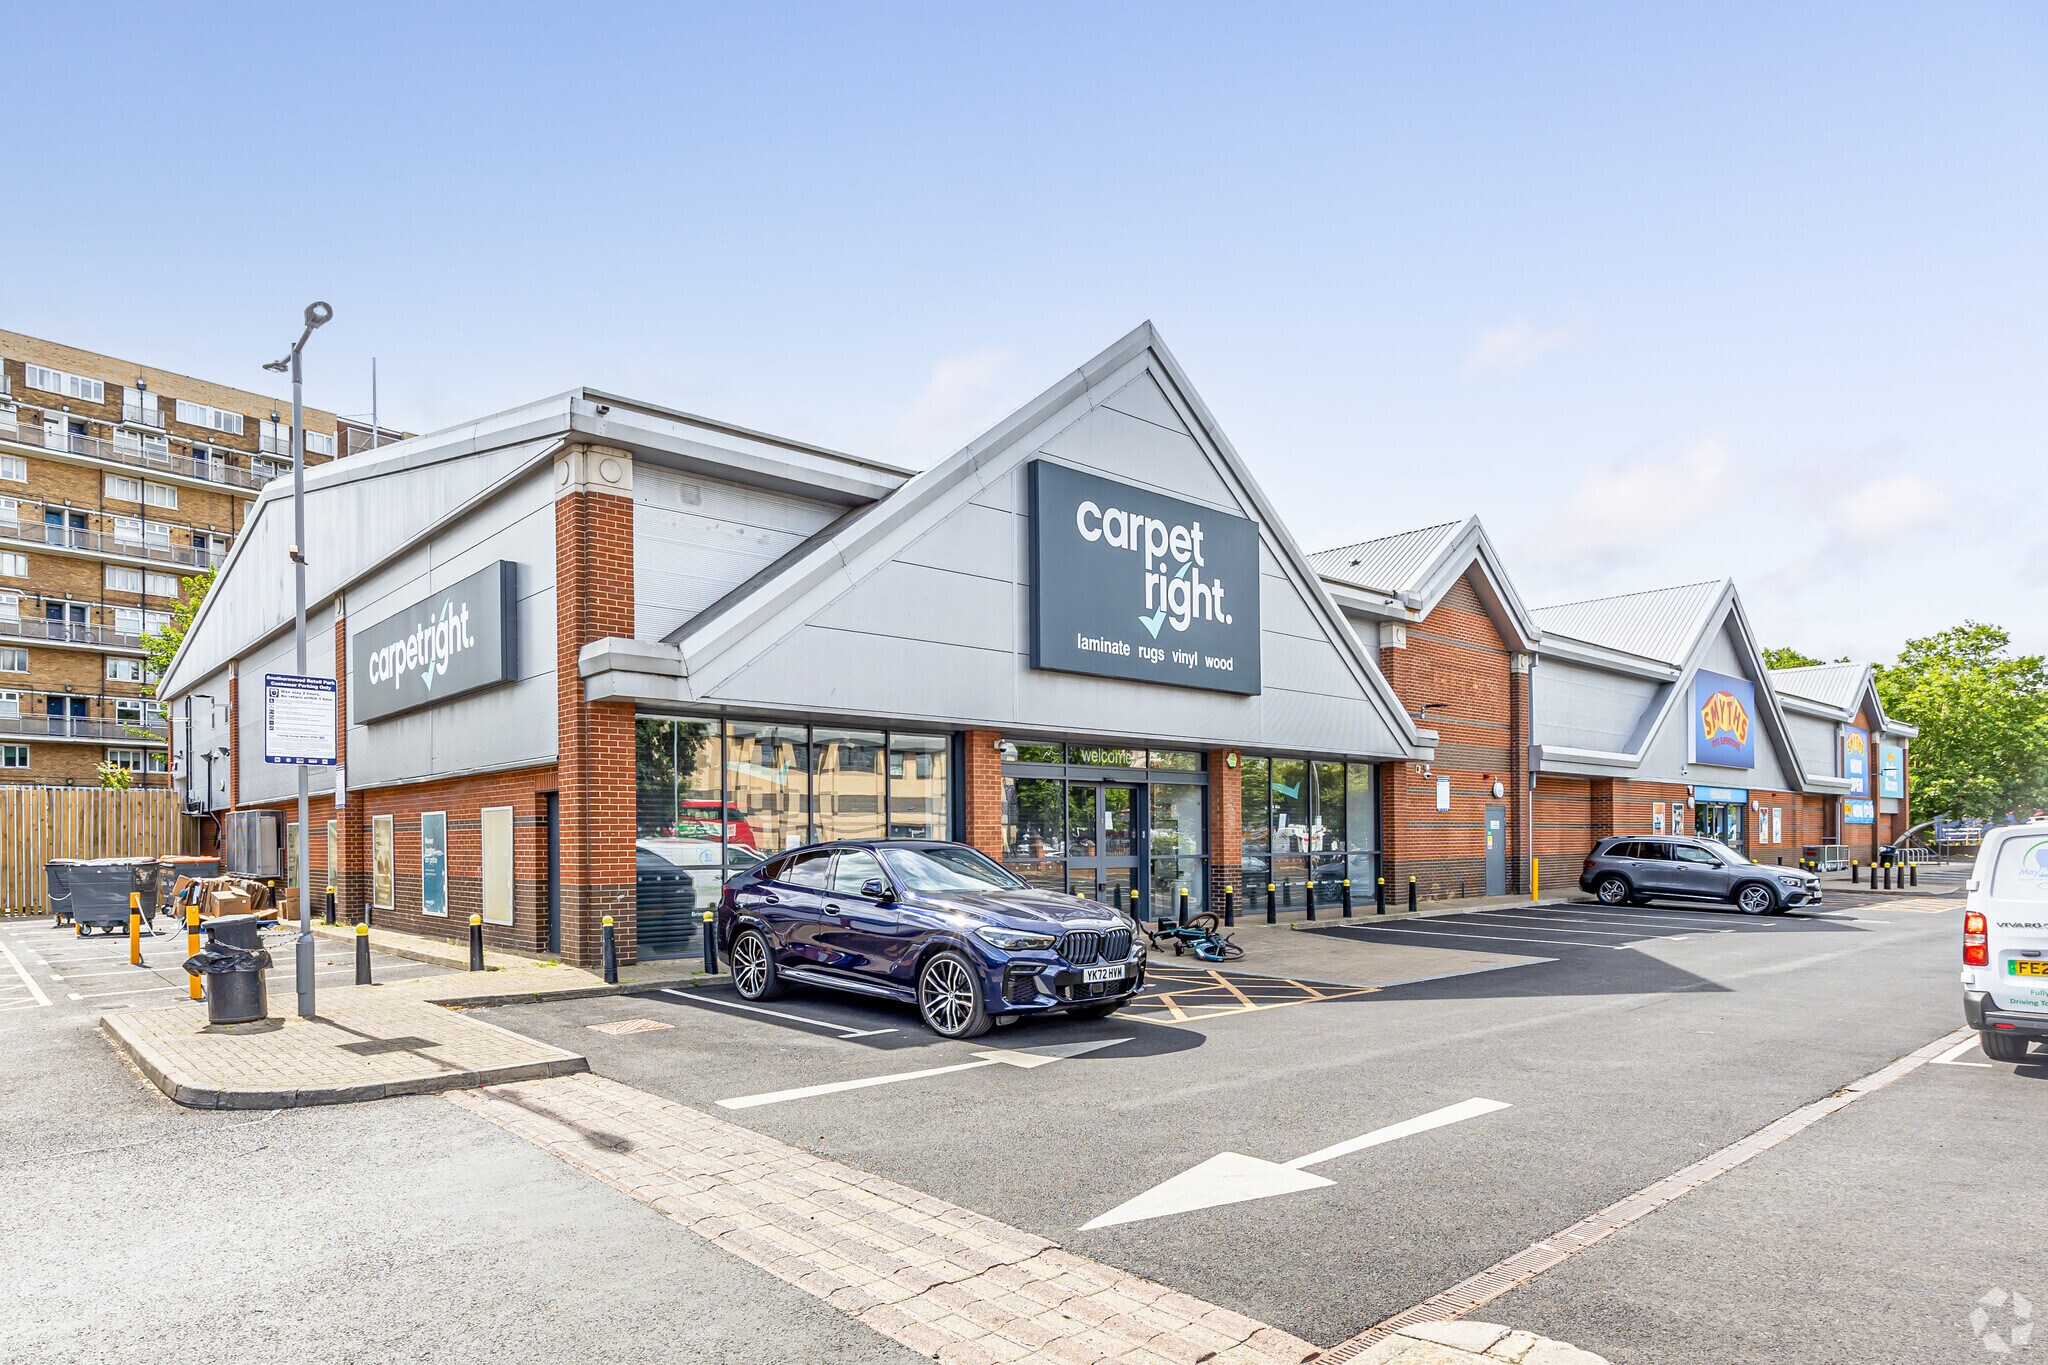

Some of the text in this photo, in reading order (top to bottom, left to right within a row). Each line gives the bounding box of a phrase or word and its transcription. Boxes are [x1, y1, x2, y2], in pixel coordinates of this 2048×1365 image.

[1076, 500, 1205, 571] carpet
[1145, 562, 1233, 632] right.
[368, 601, 475, 690] carpetright.
[1077, 633, 1234, 671] laminate rugs vinyl wood
[266, 675, 306, 683] Southernwood
[270, 680, 298, 688] Customer
[1703, 698, 1748, 741] SMYTHS
[1081, 747, 1132, 765] welcome
[1087, 968, 1108, 981] YK72
[2009, 998, 2039, 1007] Driving
